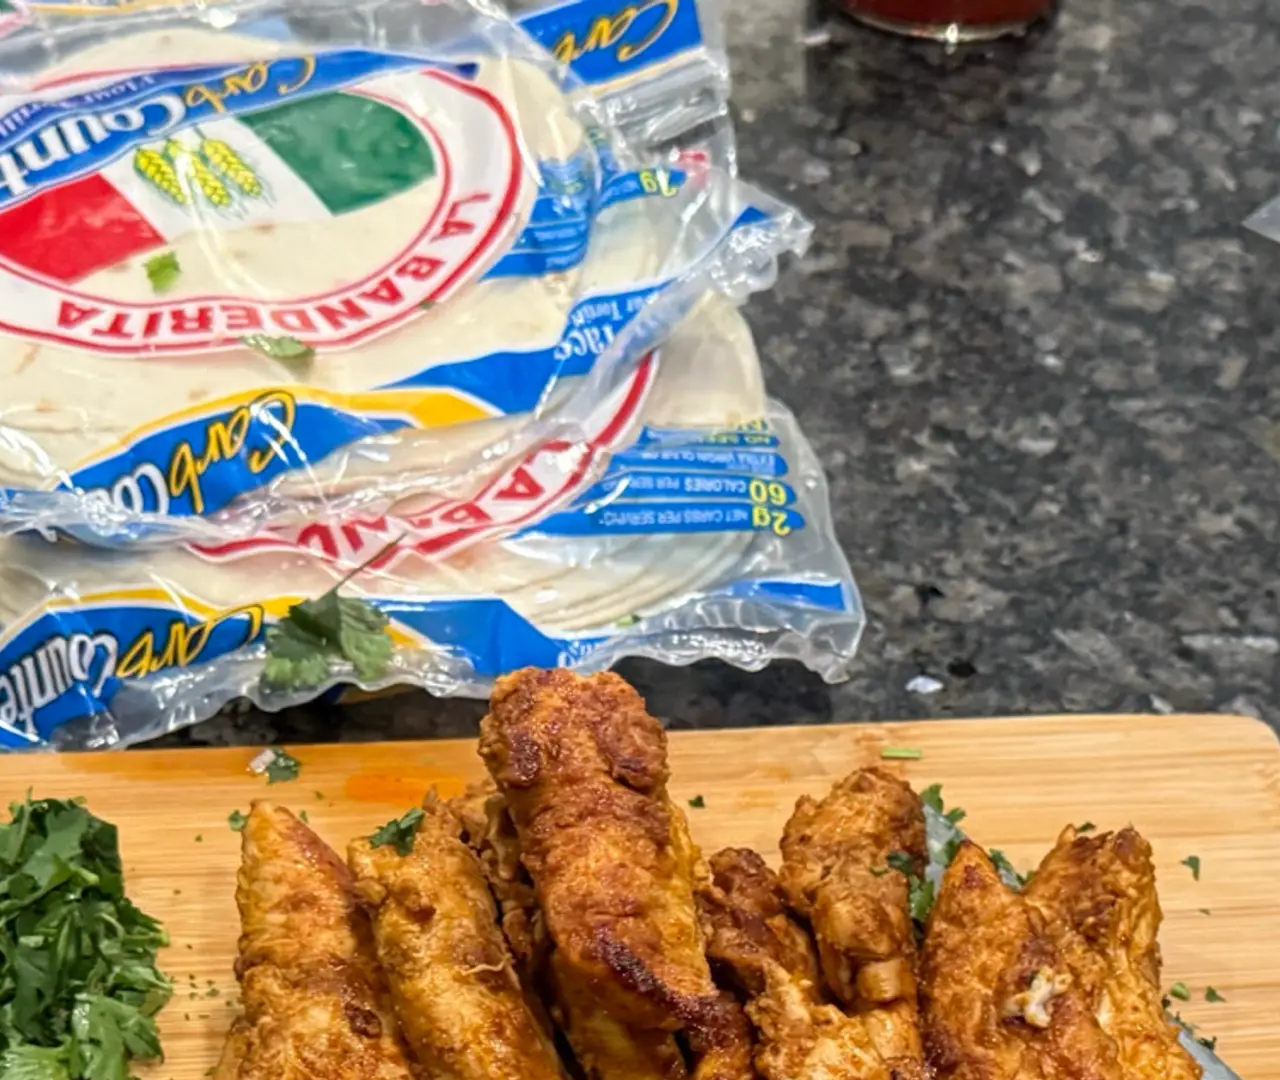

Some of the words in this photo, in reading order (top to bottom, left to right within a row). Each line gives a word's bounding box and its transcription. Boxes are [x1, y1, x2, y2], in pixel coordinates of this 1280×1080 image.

[81, 74, 157, 107] Flour
[187, 54, 317, 114] Carb
[429, 192, 492, 243] LA
[57, 254, 448, 339] BANDERITA
[168, 390, 297, 514] Carb
[656, 476, 681, 490] PER
[684, 477, 746, 493] CALORIES
[748, 479, 788, 506] 60
[657, 510, 682, 525] PER
[683, 510, 722, 525] CARBS
[724, 509, 748, 522] NET
[752, 505, 791, 536] 2g
[114, 603, 265, 680] Carb
